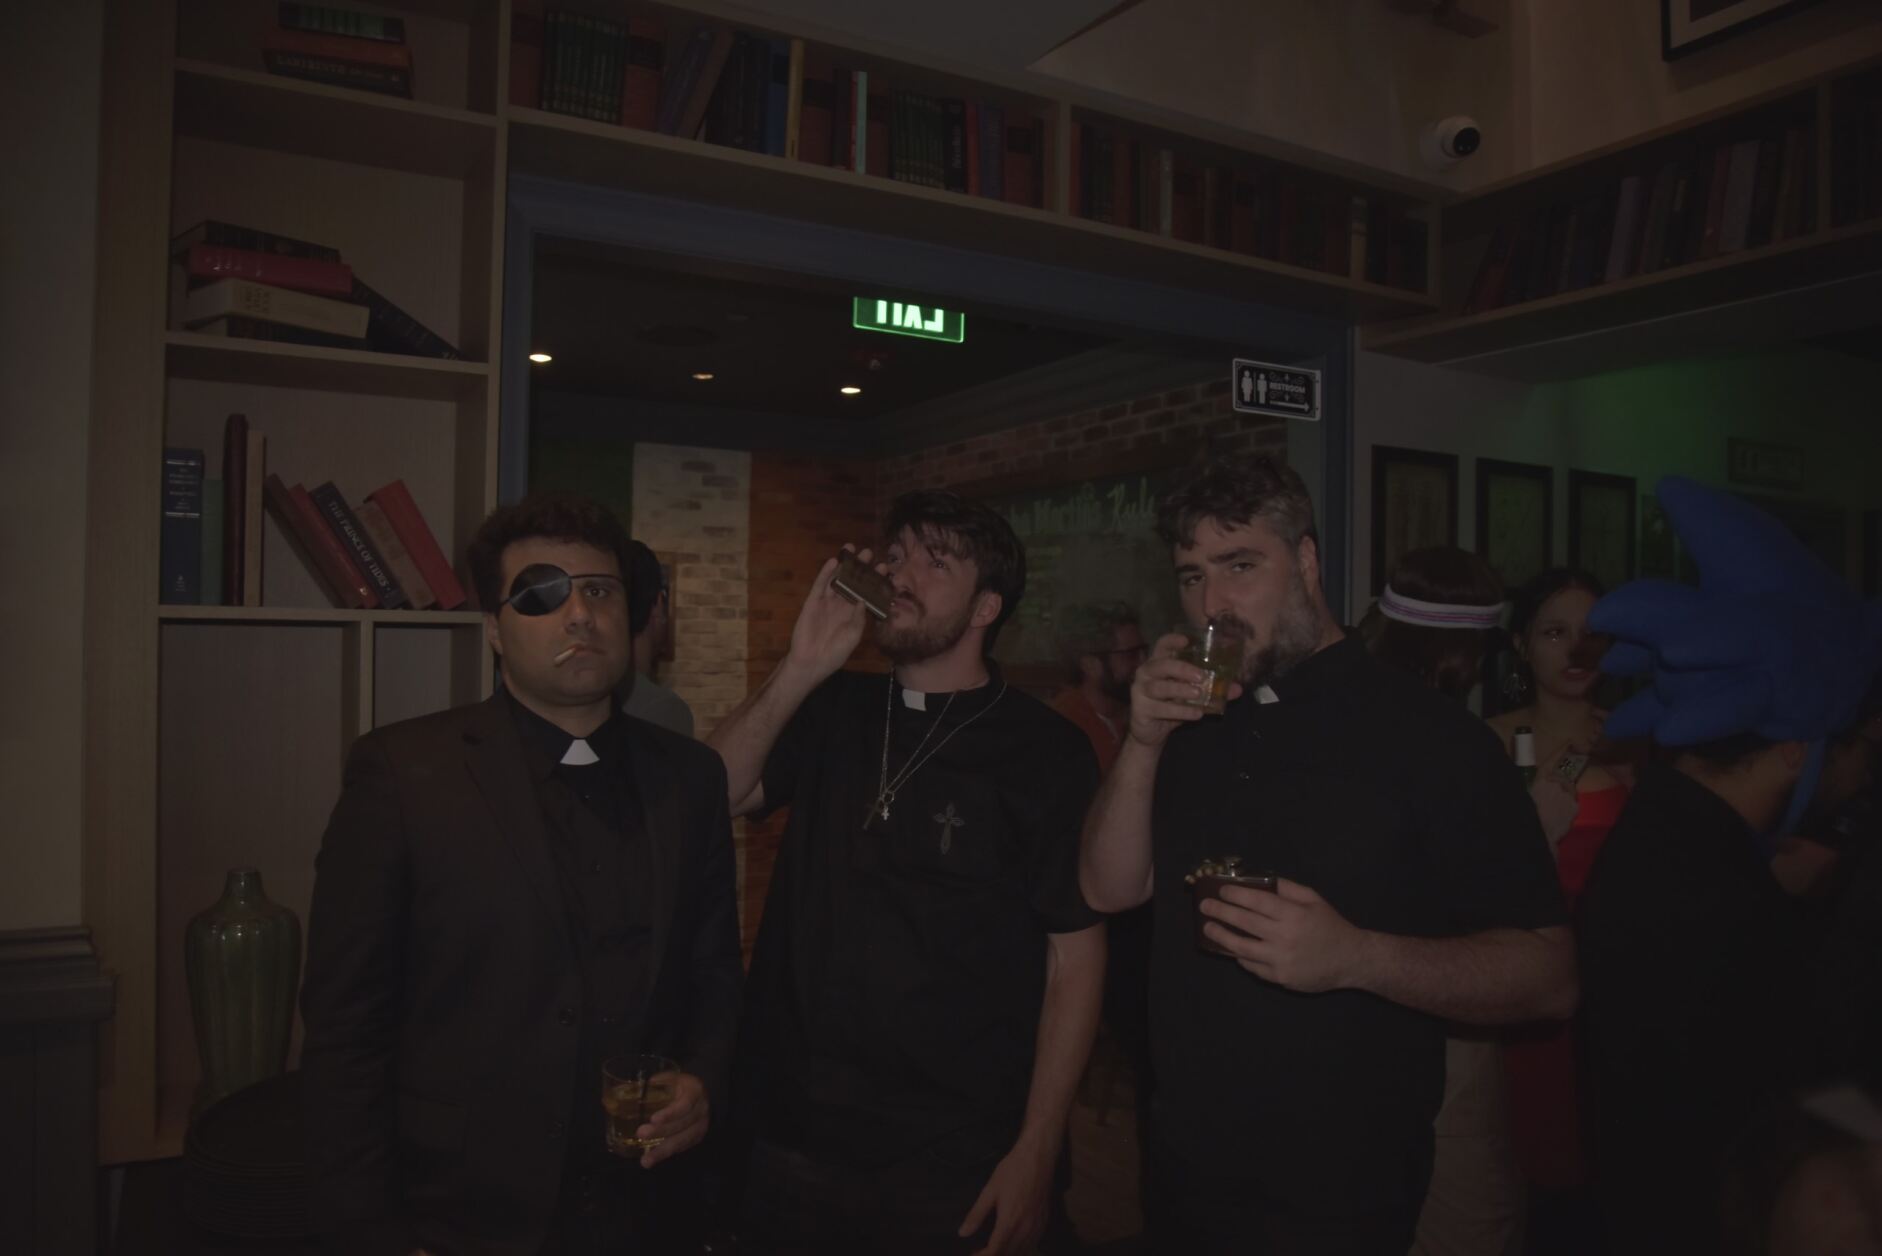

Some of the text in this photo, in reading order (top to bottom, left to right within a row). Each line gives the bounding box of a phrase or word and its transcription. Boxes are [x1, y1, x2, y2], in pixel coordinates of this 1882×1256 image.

[1269, 382, 1306, 394] RESTROOM
[328, 502, 391, 587] THE PRINCE OF TIDES
